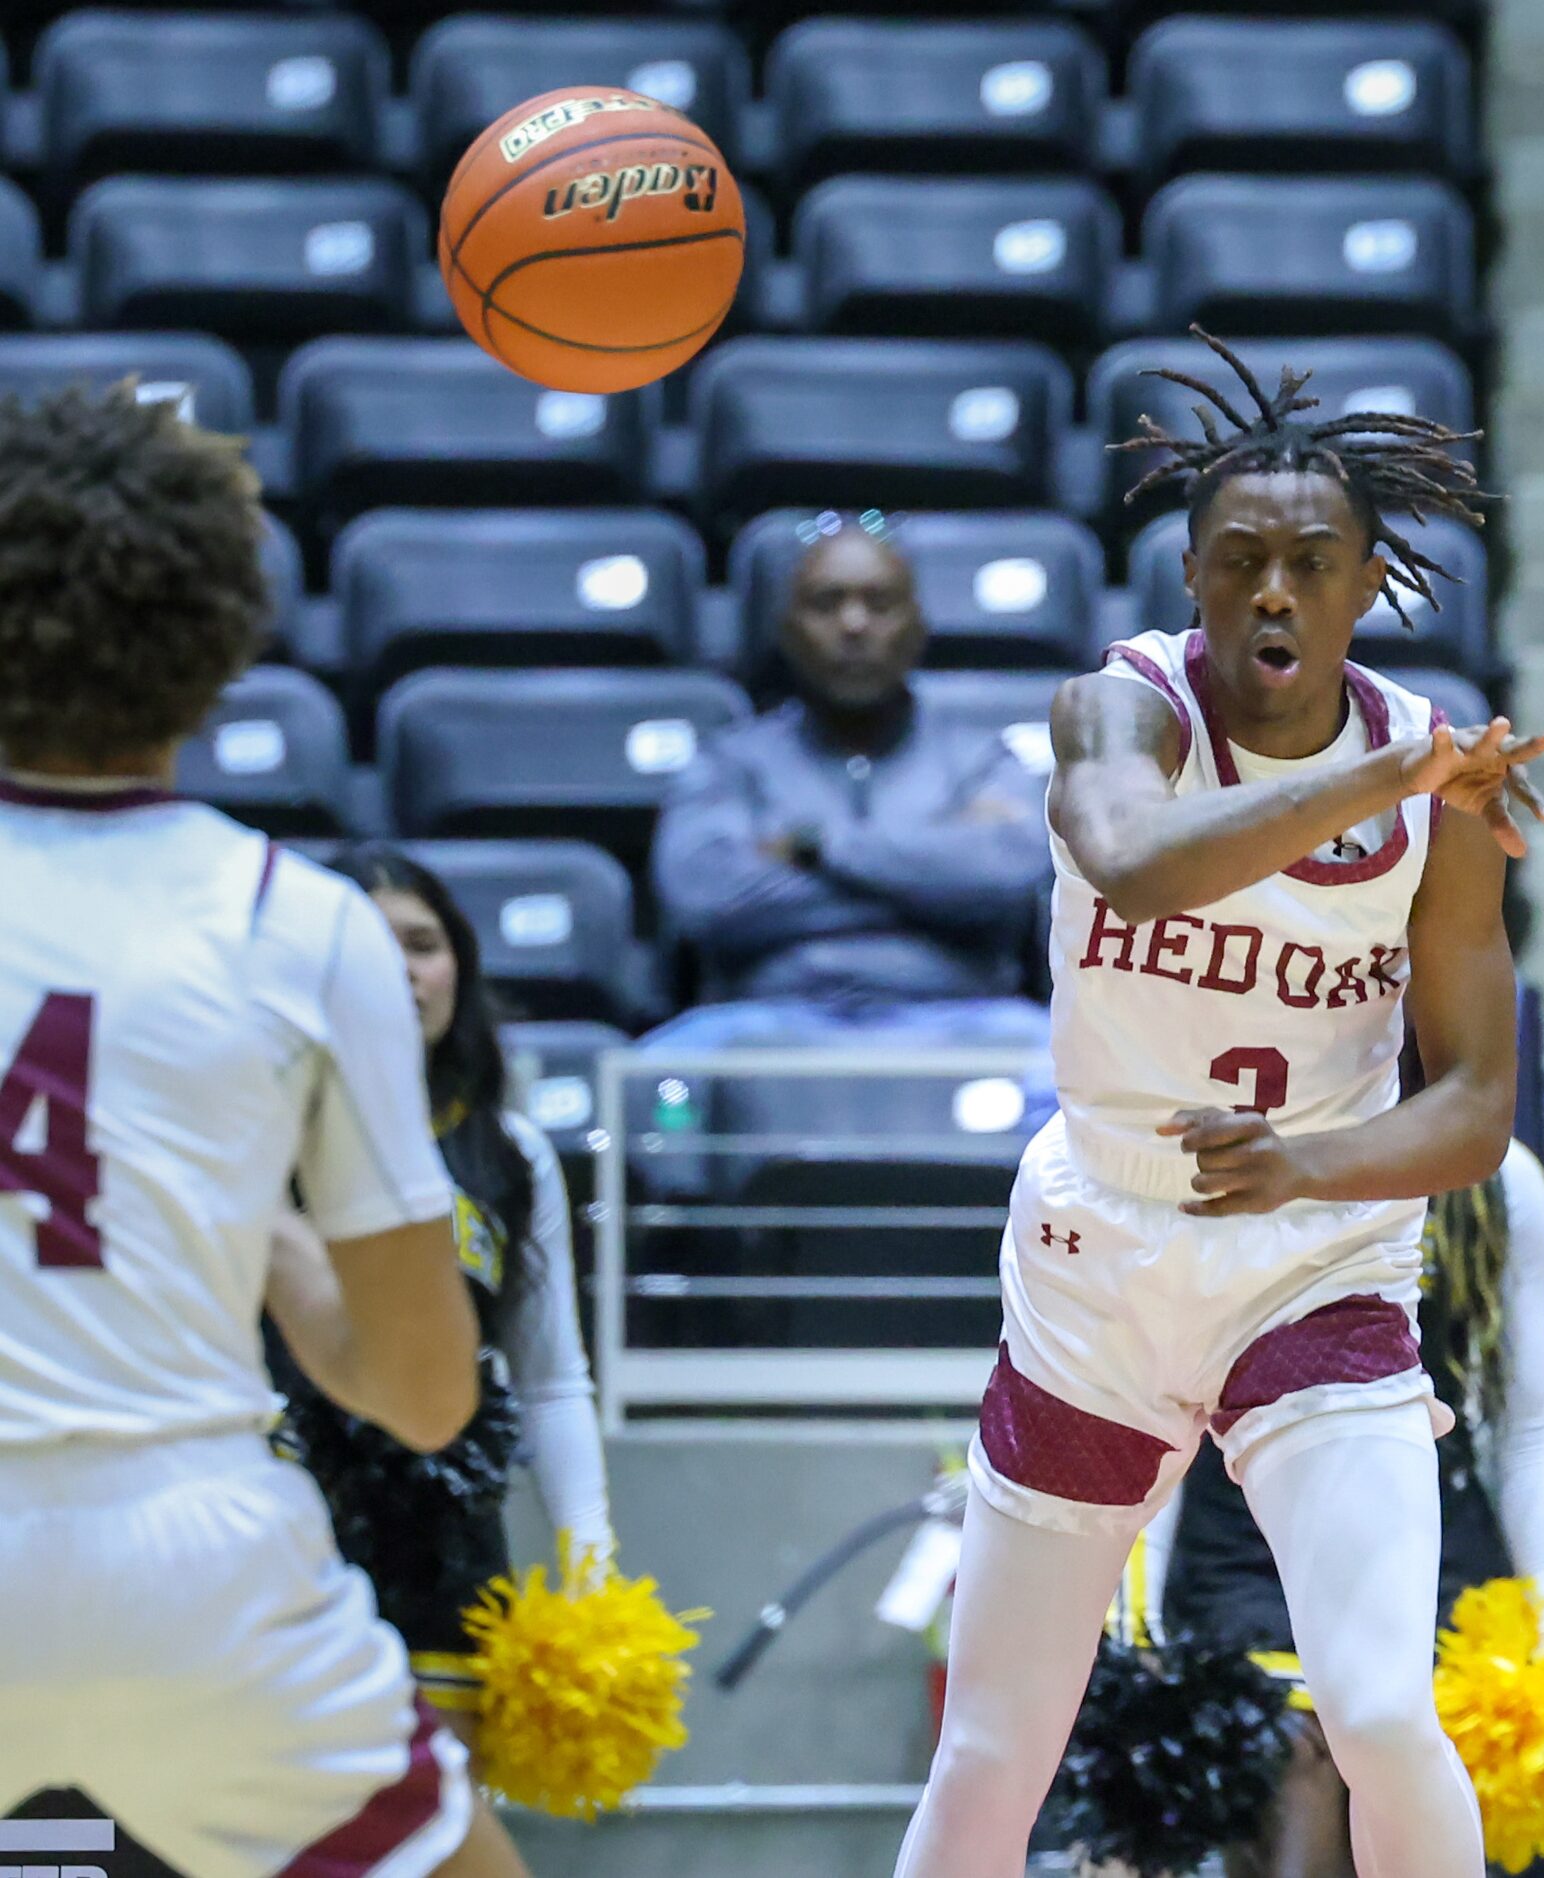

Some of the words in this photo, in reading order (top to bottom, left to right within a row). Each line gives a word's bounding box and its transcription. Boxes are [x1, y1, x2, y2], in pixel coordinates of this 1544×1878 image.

[542, 163, 718, 222] Baden
[1080, 897, 1264, 995] RED
[1277, 942, 1408, 1009] OAK
[0, 992, 105, 1269] 4
